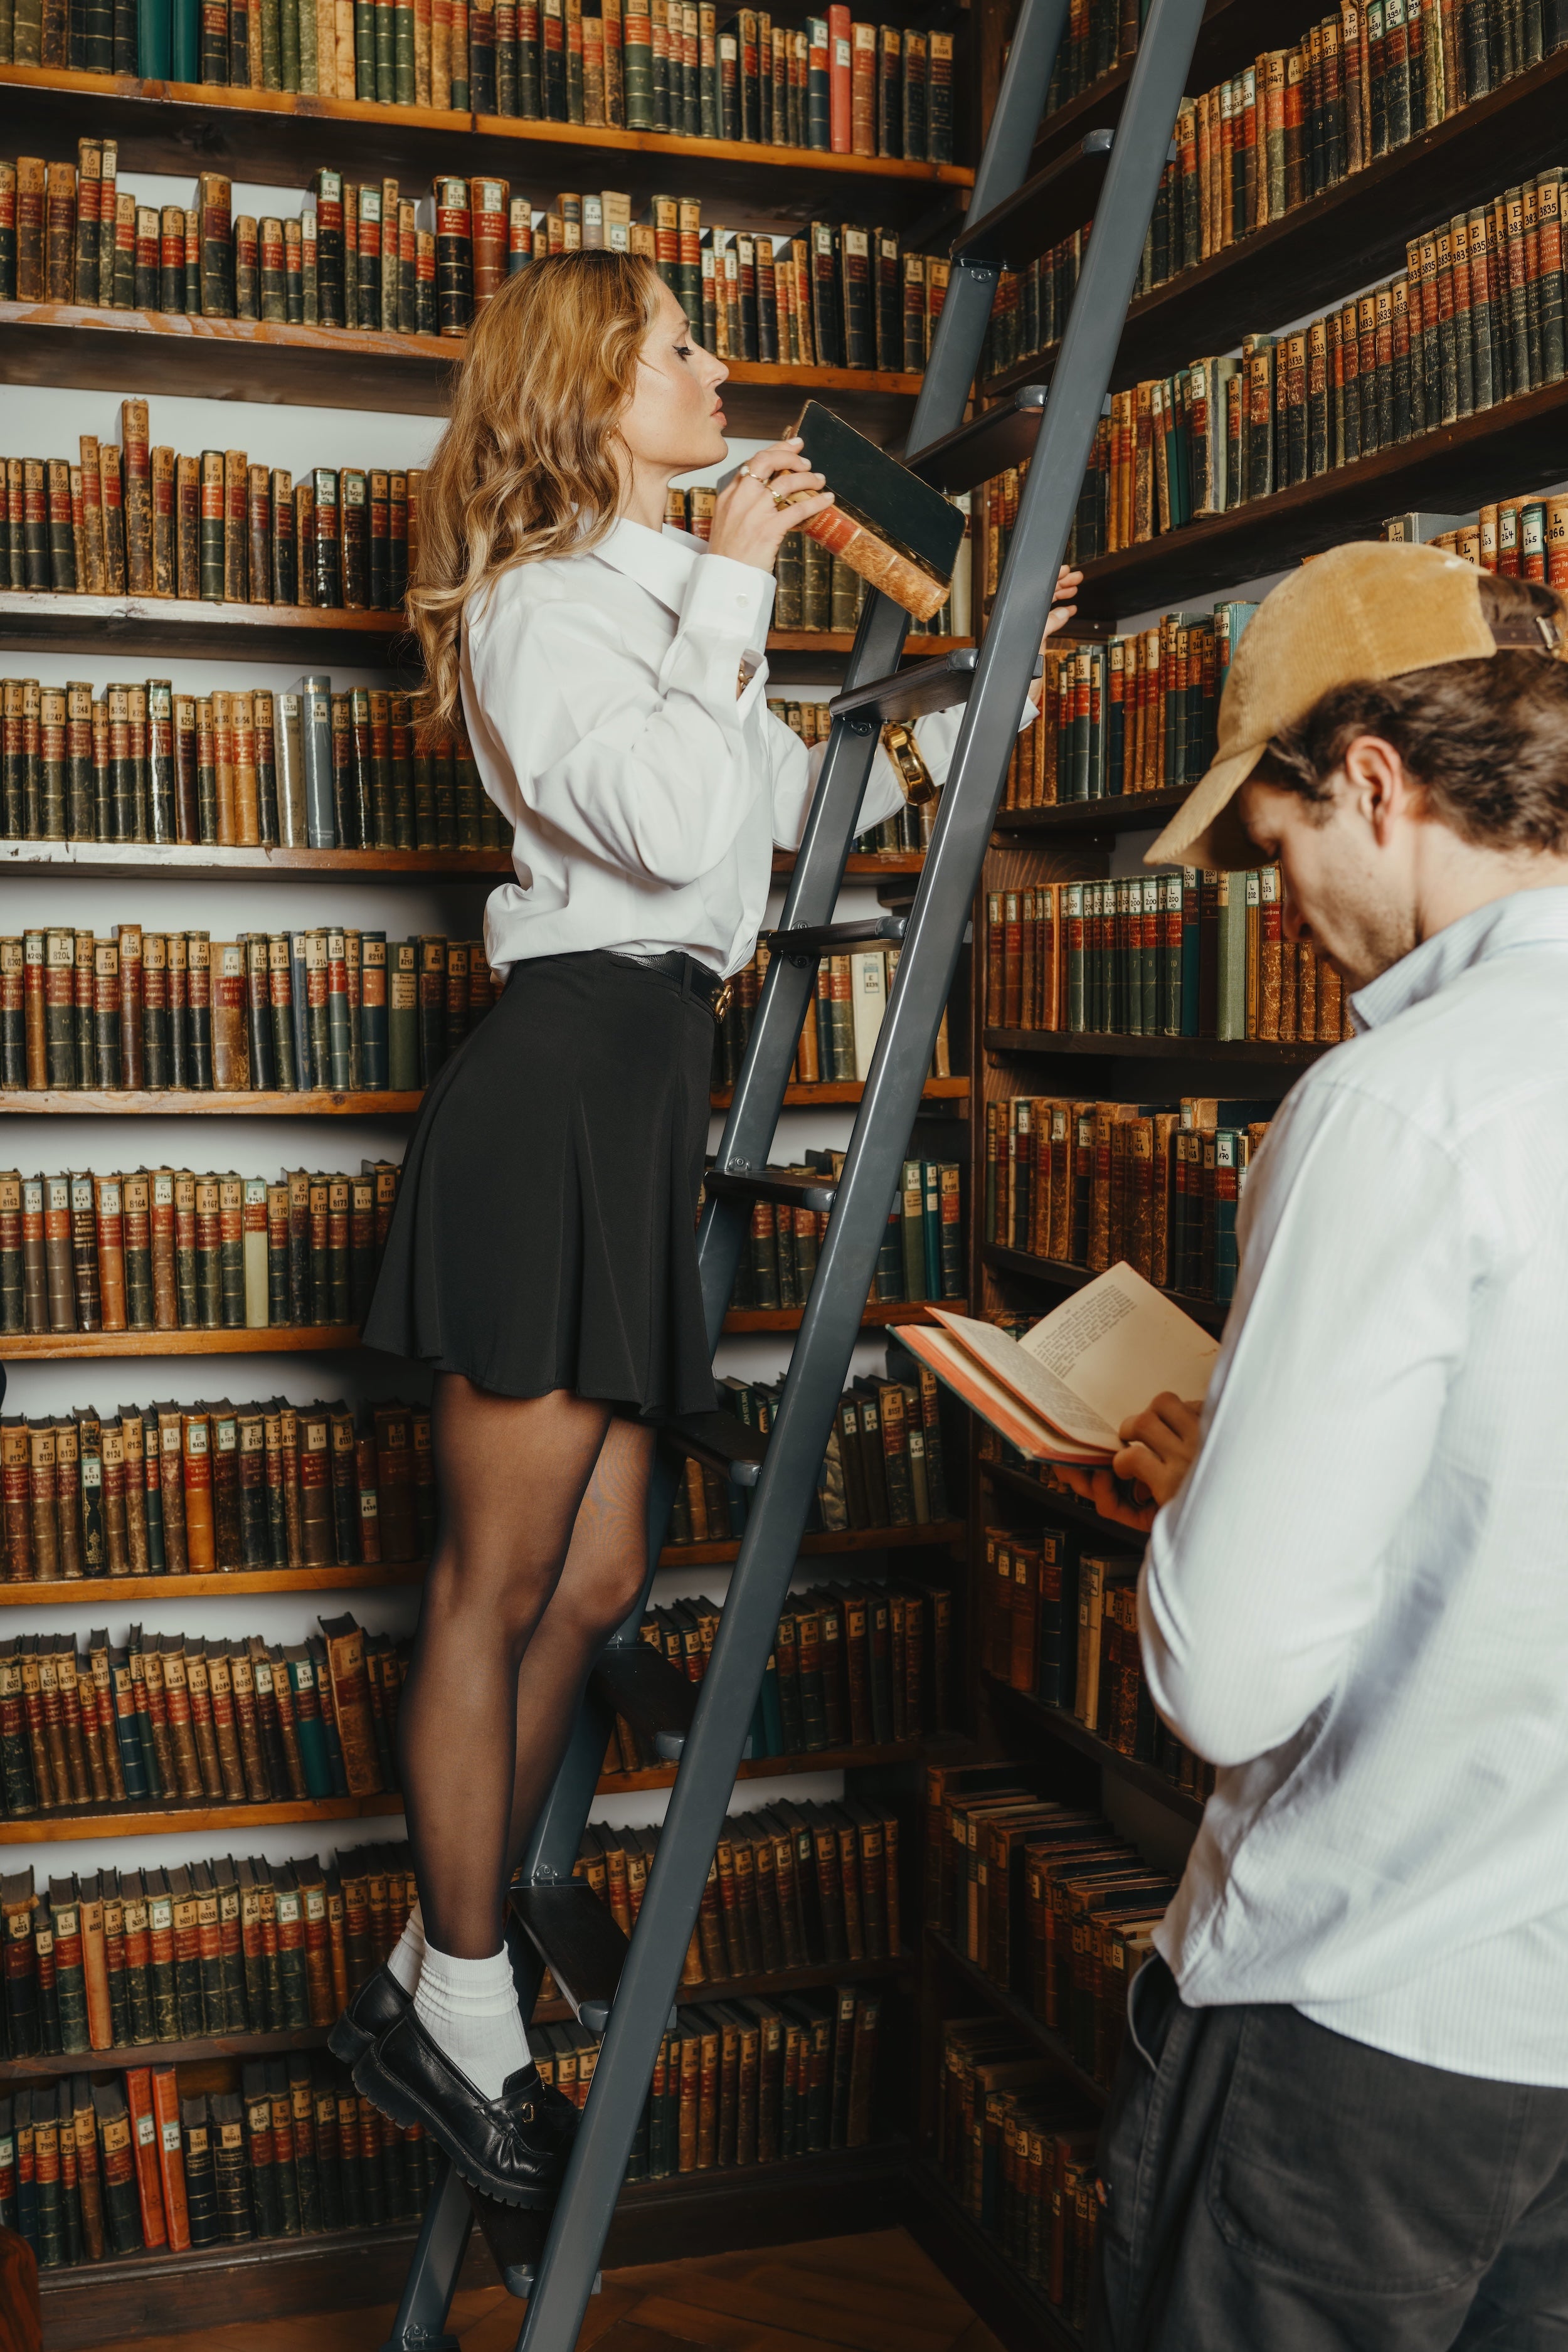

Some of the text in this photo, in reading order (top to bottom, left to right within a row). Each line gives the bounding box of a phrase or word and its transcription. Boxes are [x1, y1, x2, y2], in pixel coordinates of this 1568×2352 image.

[1391, 1, 1395, 10] E
[1348, 14, 1355, 23] E
[1324, 31, 1330, 43] E
[1270, 62, 1277, 73] E
[1544, 190, 1551, 200] E
[1513, 206, 1522, 217] E
[1540, 204, 1556, 216] 3835
[147, 213, 154, 223] E
[1510, 221, 1522, 233] 383
[1471, 227, 1479, 238] E
[1441, 239, 1447, 252] E
[1456, 235, 1465, 246] E
[1424, 247, 1431, 258] E
[1470, 241, 1485, 255] 3835
[1411, 253, 1417, 265] E
[1438, 252, 1451, 267] 3835
[1421, 260, 1436, 275] 3835
[1396, 291, 1402, 301] E
[1380, 299, 1386, 308] E
[1394, 302, 1407, 314] 3833
[1362, 304, 1367, 315] E
[1377, 309, 1392, 322] 3833
[1360, 317, 1372, 330] 3833
[1313, 331, 1318, 341] E
[1292, 343, 1297, 352] E
[1290, 356, 1302, 366] 3833
[1255, 363, 1259, 372] E
[1554, 514, 1562, 524] L
[1502, 531, 1513, 541] 264
[1550, 527, 1564, 539] 266
[1525, 536, 1537, 546] 265
[118, 694, 123, 702] E
[262, 702, 268, 711] E
[60, 940, 68, 950] E
[128, 935, 135, 945] E
[12, 948, 18, 956] E
[53, 951, 70, 960] 8204
[288, 1417, 294, 1429] E
[112, 1438, 117, 1448] E
[241, 1667, 247, 1675] E
